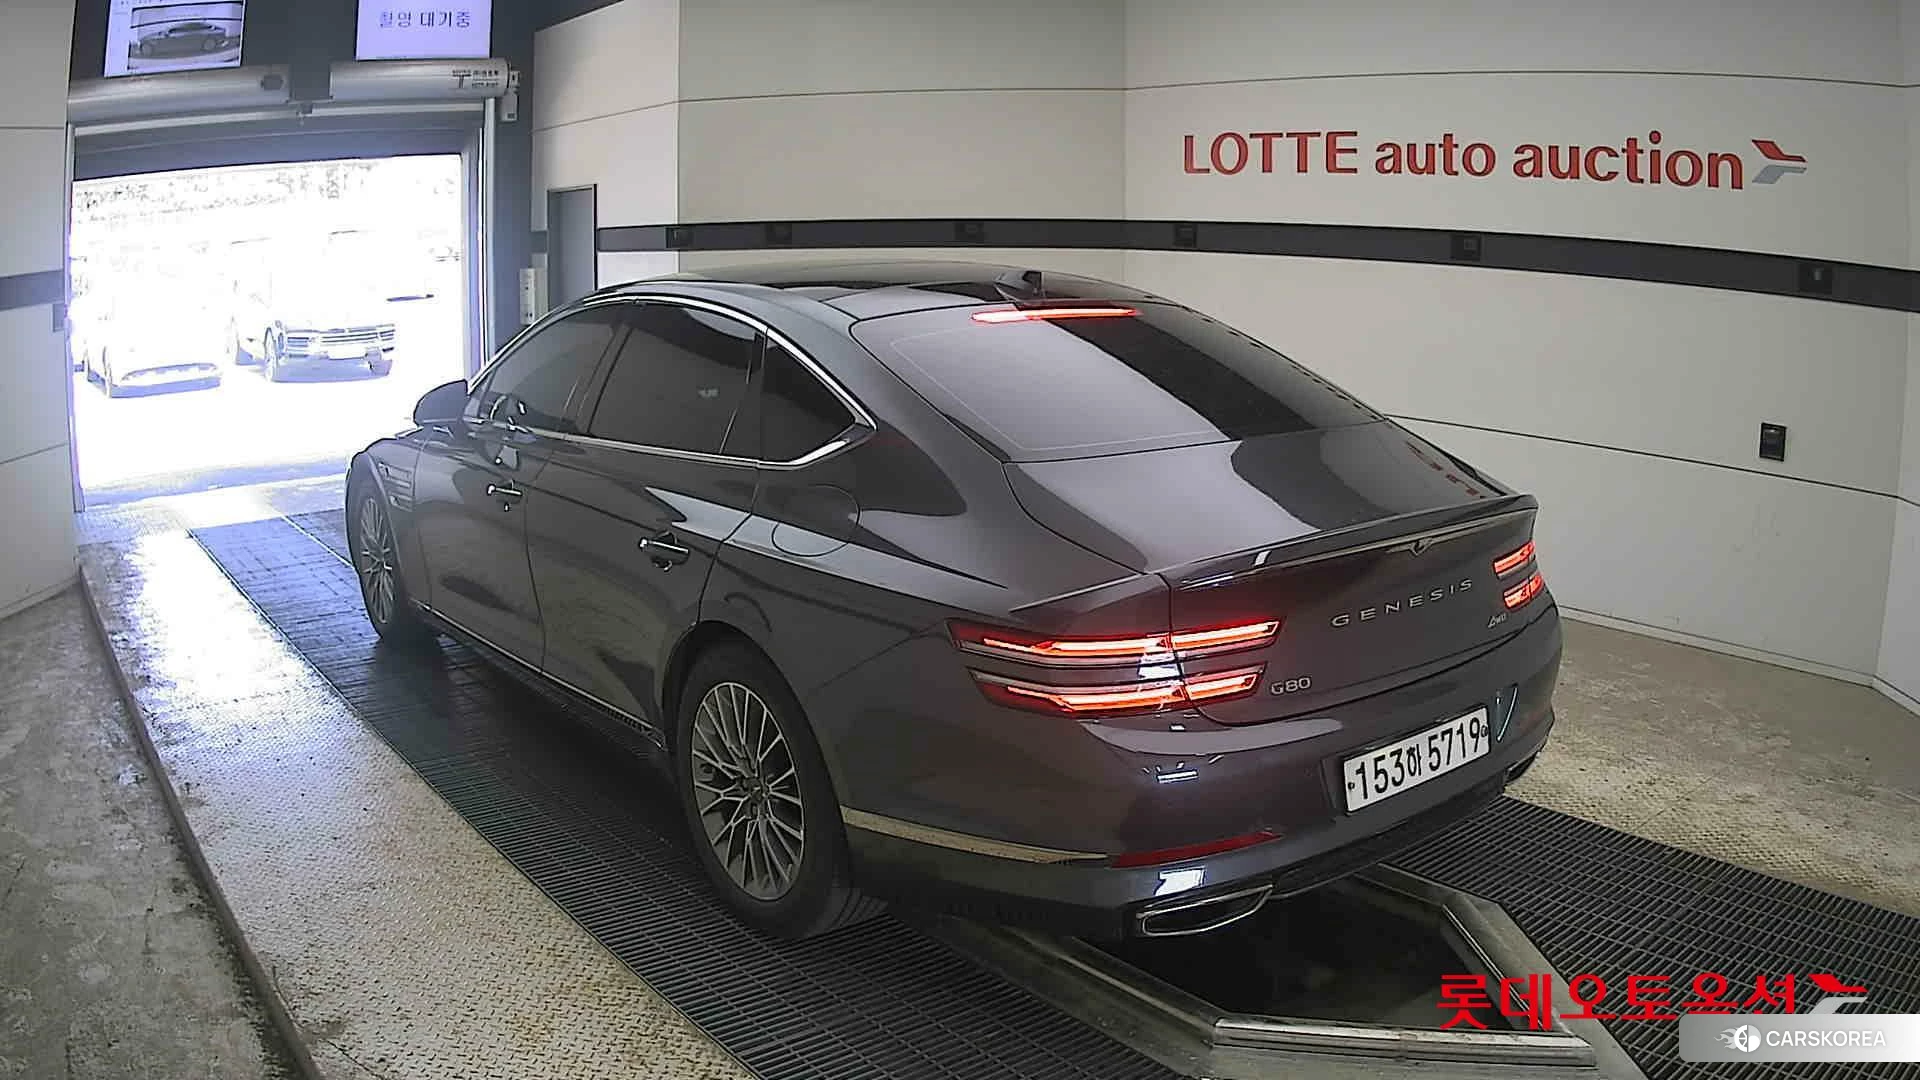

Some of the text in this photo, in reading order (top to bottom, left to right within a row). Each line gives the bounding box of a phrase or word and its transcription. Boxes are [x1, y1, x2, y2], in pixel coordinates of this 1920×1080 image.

[420, 10, 471, 28] 대기중
[1184, 130, 1744, 190] LOTTE auto auction
[1331, 579, 1472, 627] GENESIS
[1271, 677, 1311, 695] G80
[1427, 716, 1481, 772] 5719
